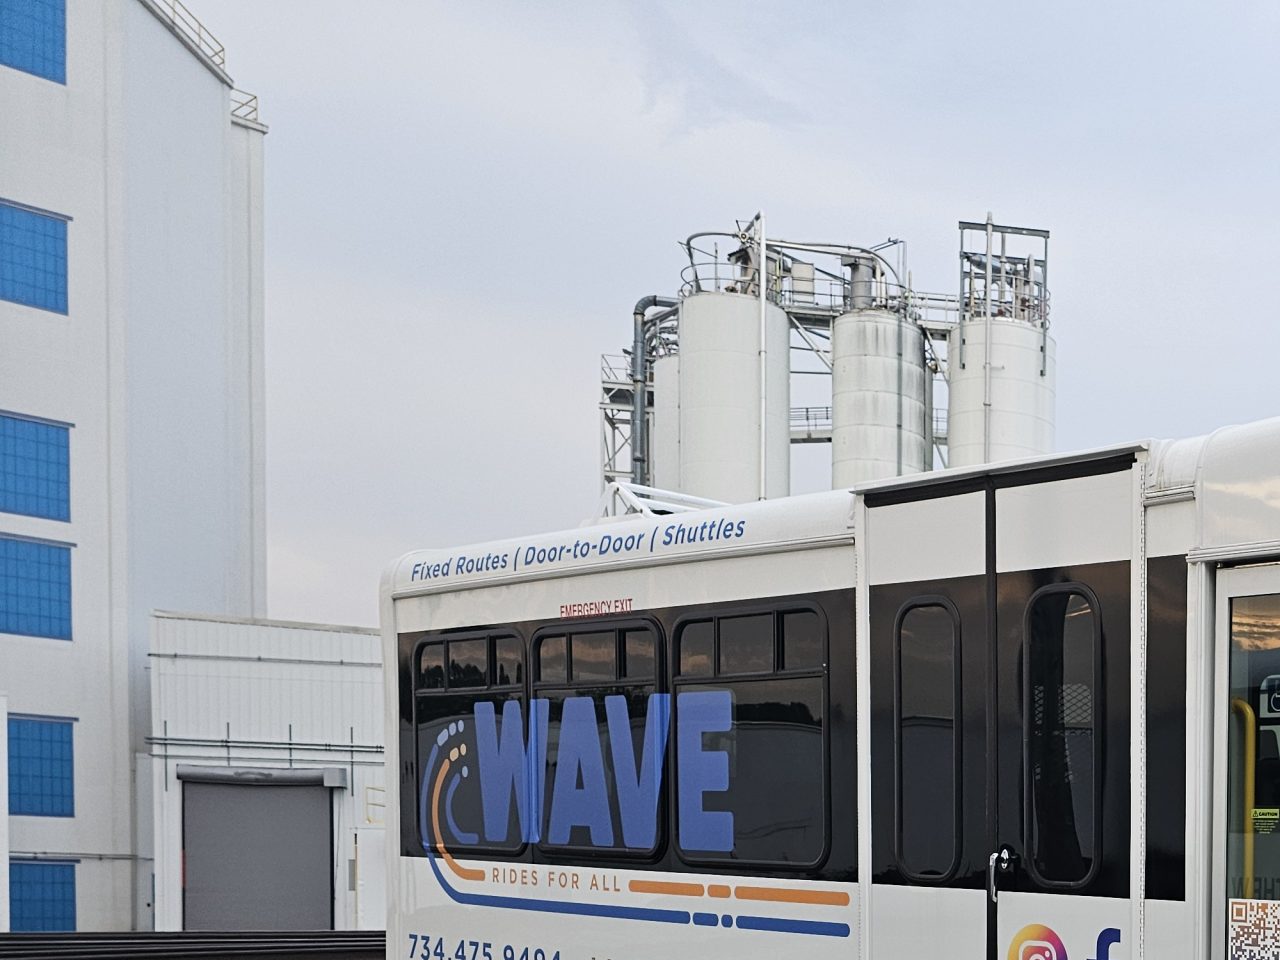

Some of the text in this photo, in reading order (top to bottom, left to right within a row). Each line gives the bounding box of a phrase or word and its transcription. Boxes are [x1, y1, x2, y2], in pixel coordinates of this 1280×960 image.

[411, 558, 453, 582] Fixed
[456, 553, 509, 575] Routes
[524, 531, 646, 566] Door-to-Door
[662, 518, 746, 546] Shuttles
[560, 598, 633, 619] EMERGENCY EXIT
[474, 690, 735, 852] WAVE
[492, 867, 621, 892] RIDES FOR ALL
